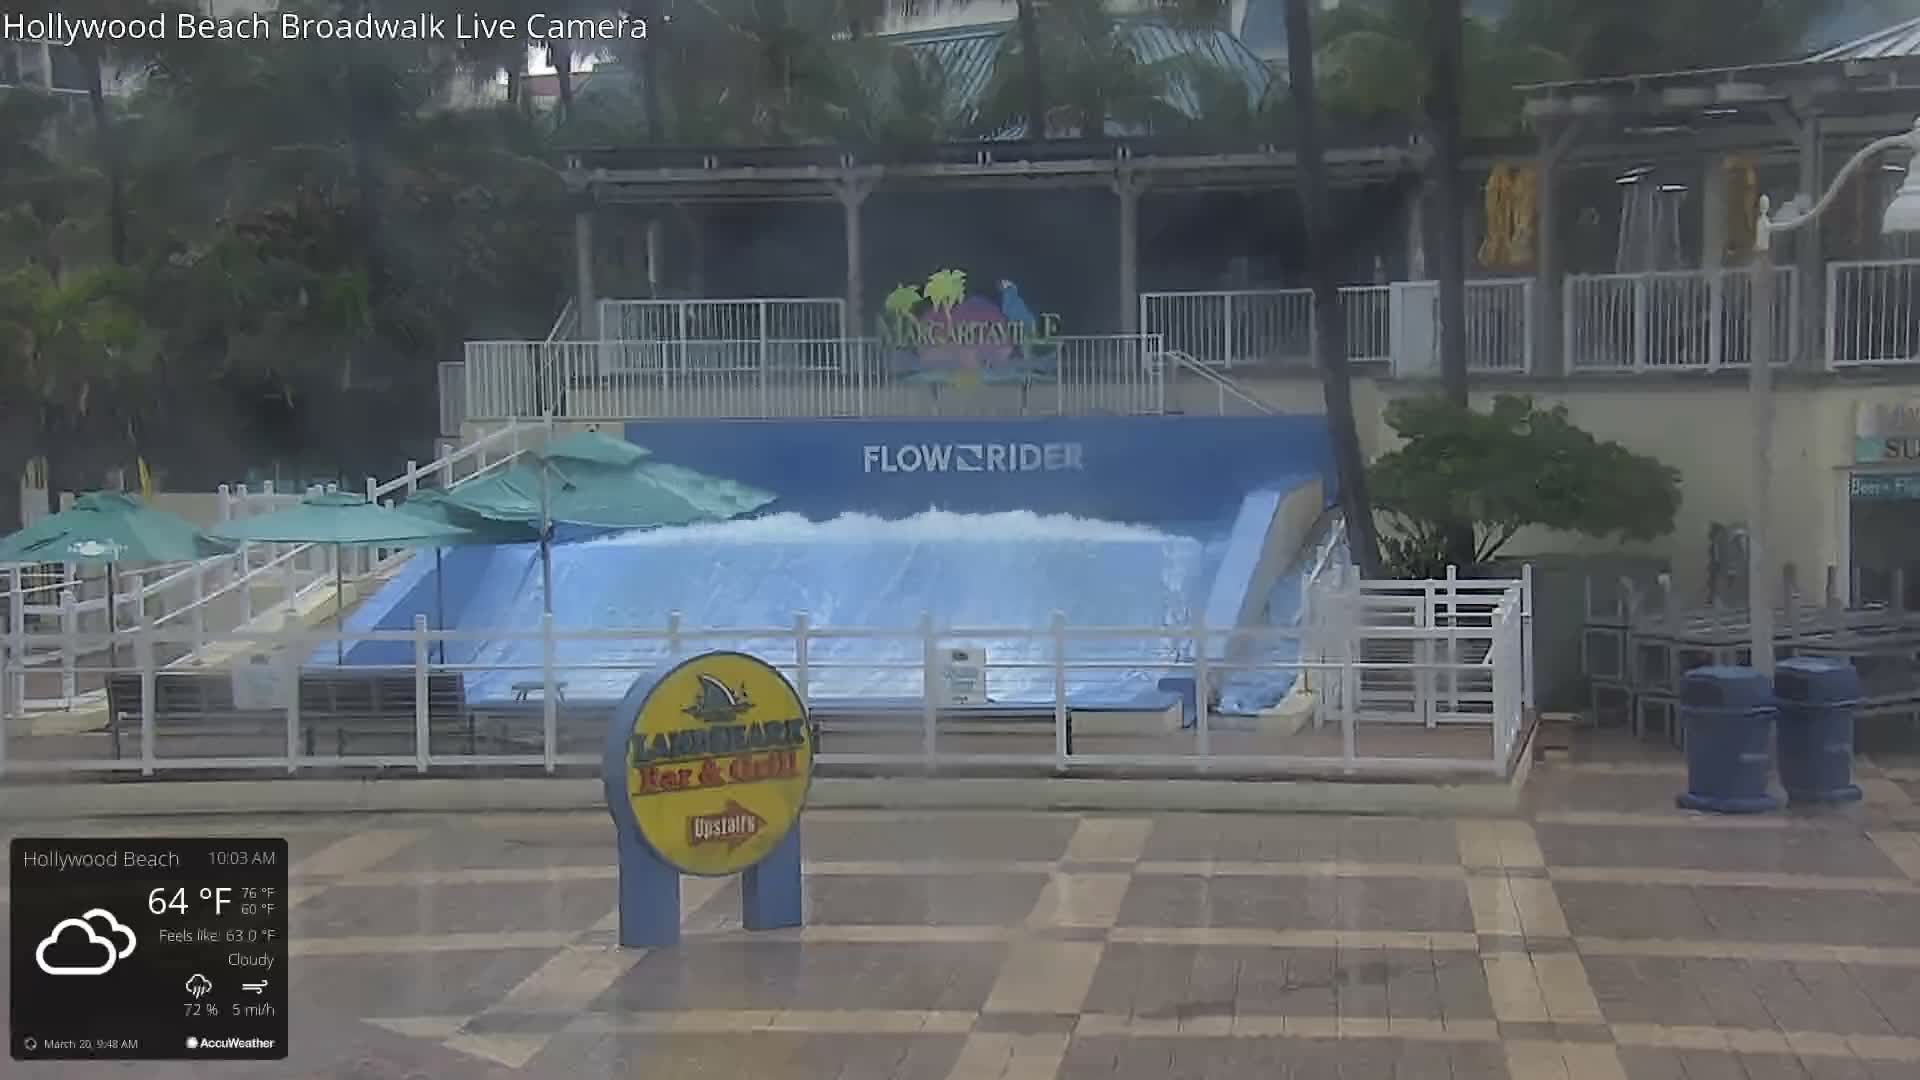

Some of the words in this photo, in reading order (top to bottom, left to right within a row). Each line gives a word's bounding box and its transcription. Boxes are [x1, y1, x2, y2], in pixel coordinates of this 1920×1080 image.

[863, 443, 952, 473] FLOW
[986, 442, 1086, 473] RIDER
[639, 766, 693, 796] Bar
[697, 757, 728, 787] &
[694, 813, 756, 840] Upstairs
